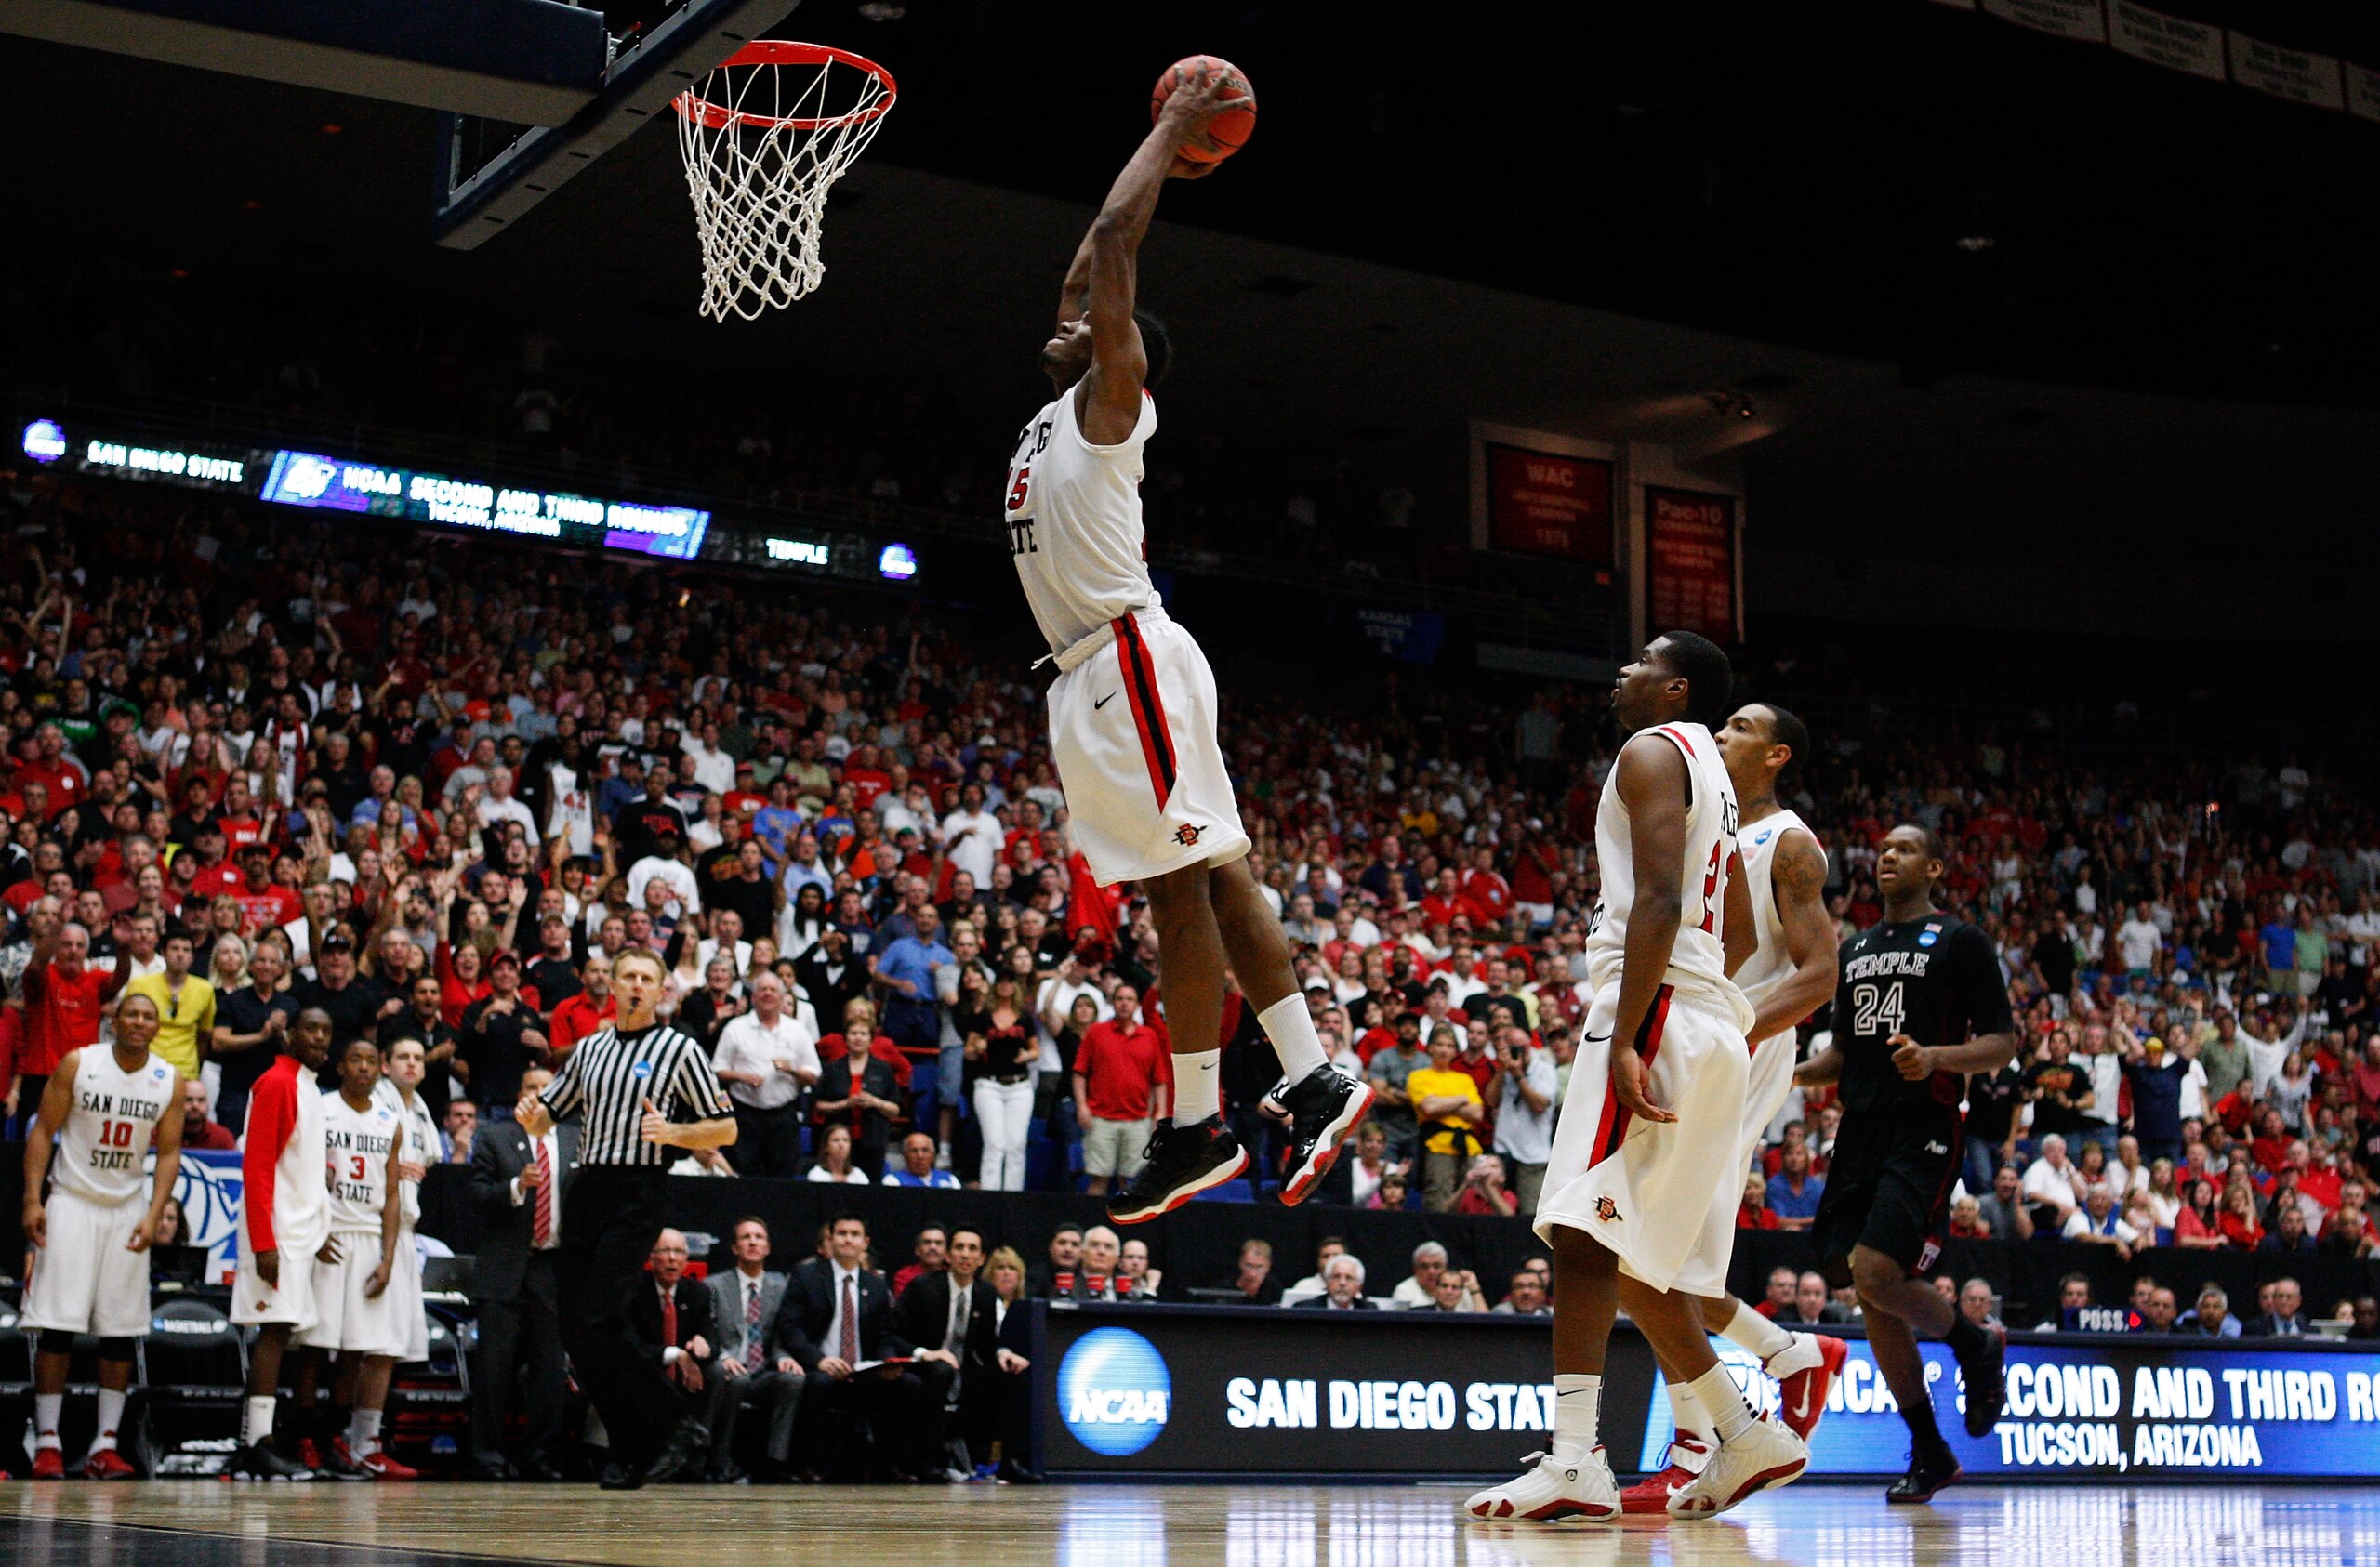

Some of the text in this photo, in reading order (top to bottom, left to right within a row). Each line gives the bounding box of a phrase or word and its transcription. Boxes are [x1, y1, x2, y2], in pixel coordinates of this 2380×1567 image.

[87, 440, 126, 467] SAN
[187, 454, 244, 482] STATE
[1526, 464, 1574, 488] WAC
[342, 466, 402, 495] NCAA
[410, 476, 494, 509] SECOND
[496, 488, 540, 517] AND
[766, 537, 828, 565] TEMPLE
[1845, 951, 1930, 983] TEMPLE
[1853, 981, 1906, 1036] 24
[82, 1092, 159, 1121] SAN DIEGO
[99, 1119, 133, 1147] 10
[326, 1129, 351, 1148] SAN
[89, 1149, 134, 1170] STATE
[350, 1155, 365, 1180] 3
[336, 1181, 374, 1204] STATE
[2079, 1308, 2129, 1332] POSS.
[1068, 1389, 1169, 1425] NCAA
[1226, 1376, 1556, 1431] SAN DIEGO STAT
[2132, 1366, 2215, 1420] AND
[2222, 1369, 2337, 1421] THIRD
[1994, 1422, 2263, 1473] TUCSON, ARIZONA
